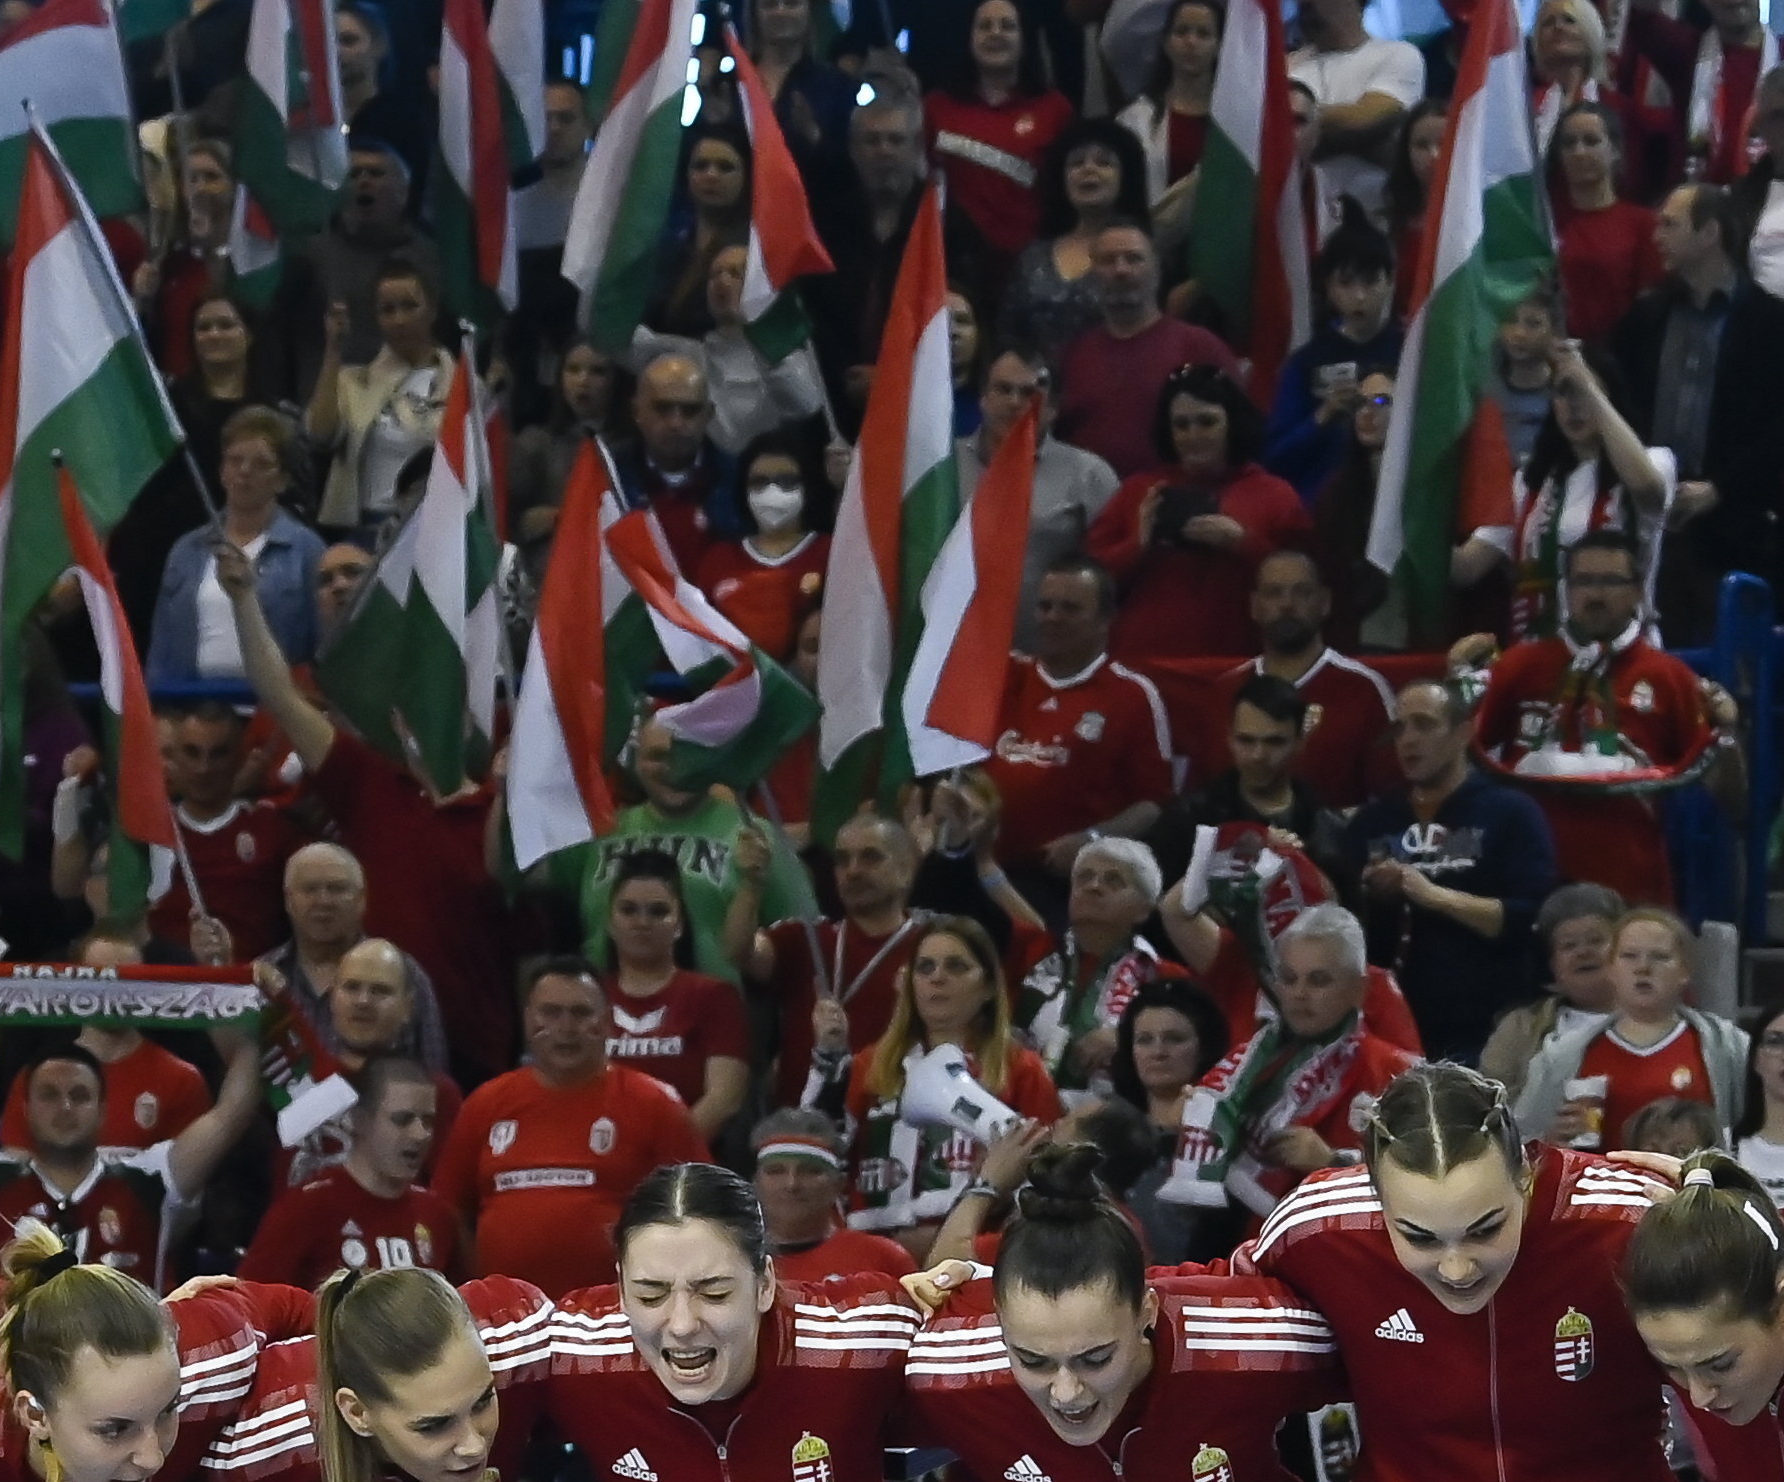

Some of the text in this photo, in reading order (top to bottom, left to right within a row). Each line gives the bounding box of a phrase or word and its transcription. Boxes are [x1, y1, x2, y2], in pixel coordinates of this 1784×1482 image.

[604, 1037, 683, 1058] rima
[375, 1236, 415, 1270] 10
[1373, 1324, 1425, 1344] adidas
[611, 1460, 659, 1482] adidas
